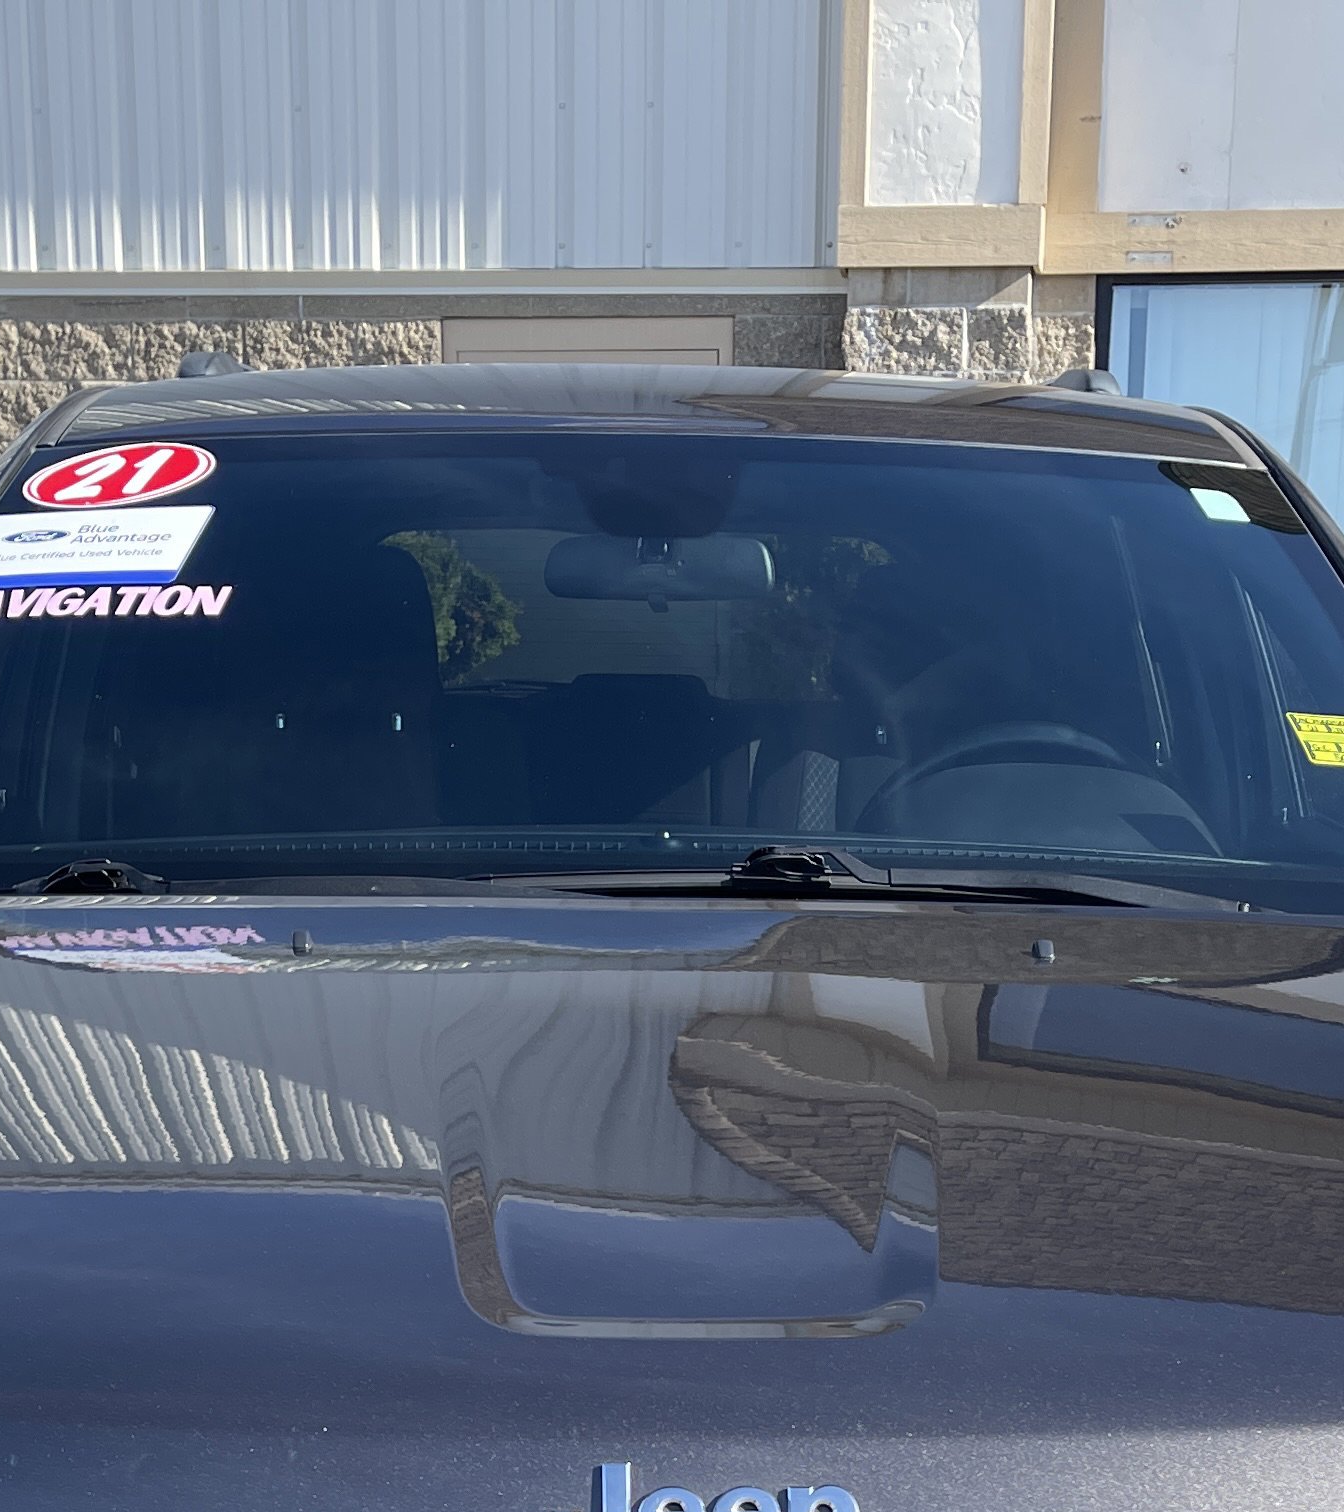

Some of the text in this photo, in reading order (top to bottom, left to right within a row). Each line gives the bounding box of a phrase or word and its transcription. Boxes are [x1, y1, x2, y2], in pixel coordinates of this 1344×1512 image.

[53, 449, 175, 501] 21
[77, 524, 120, 534] Blue
[70, 533, 172, 545] Advantage
[20, 550, 75, 561] Certified
[78, 549, 112, 558] Used
[116, 547, 163, 557] Vehicle
